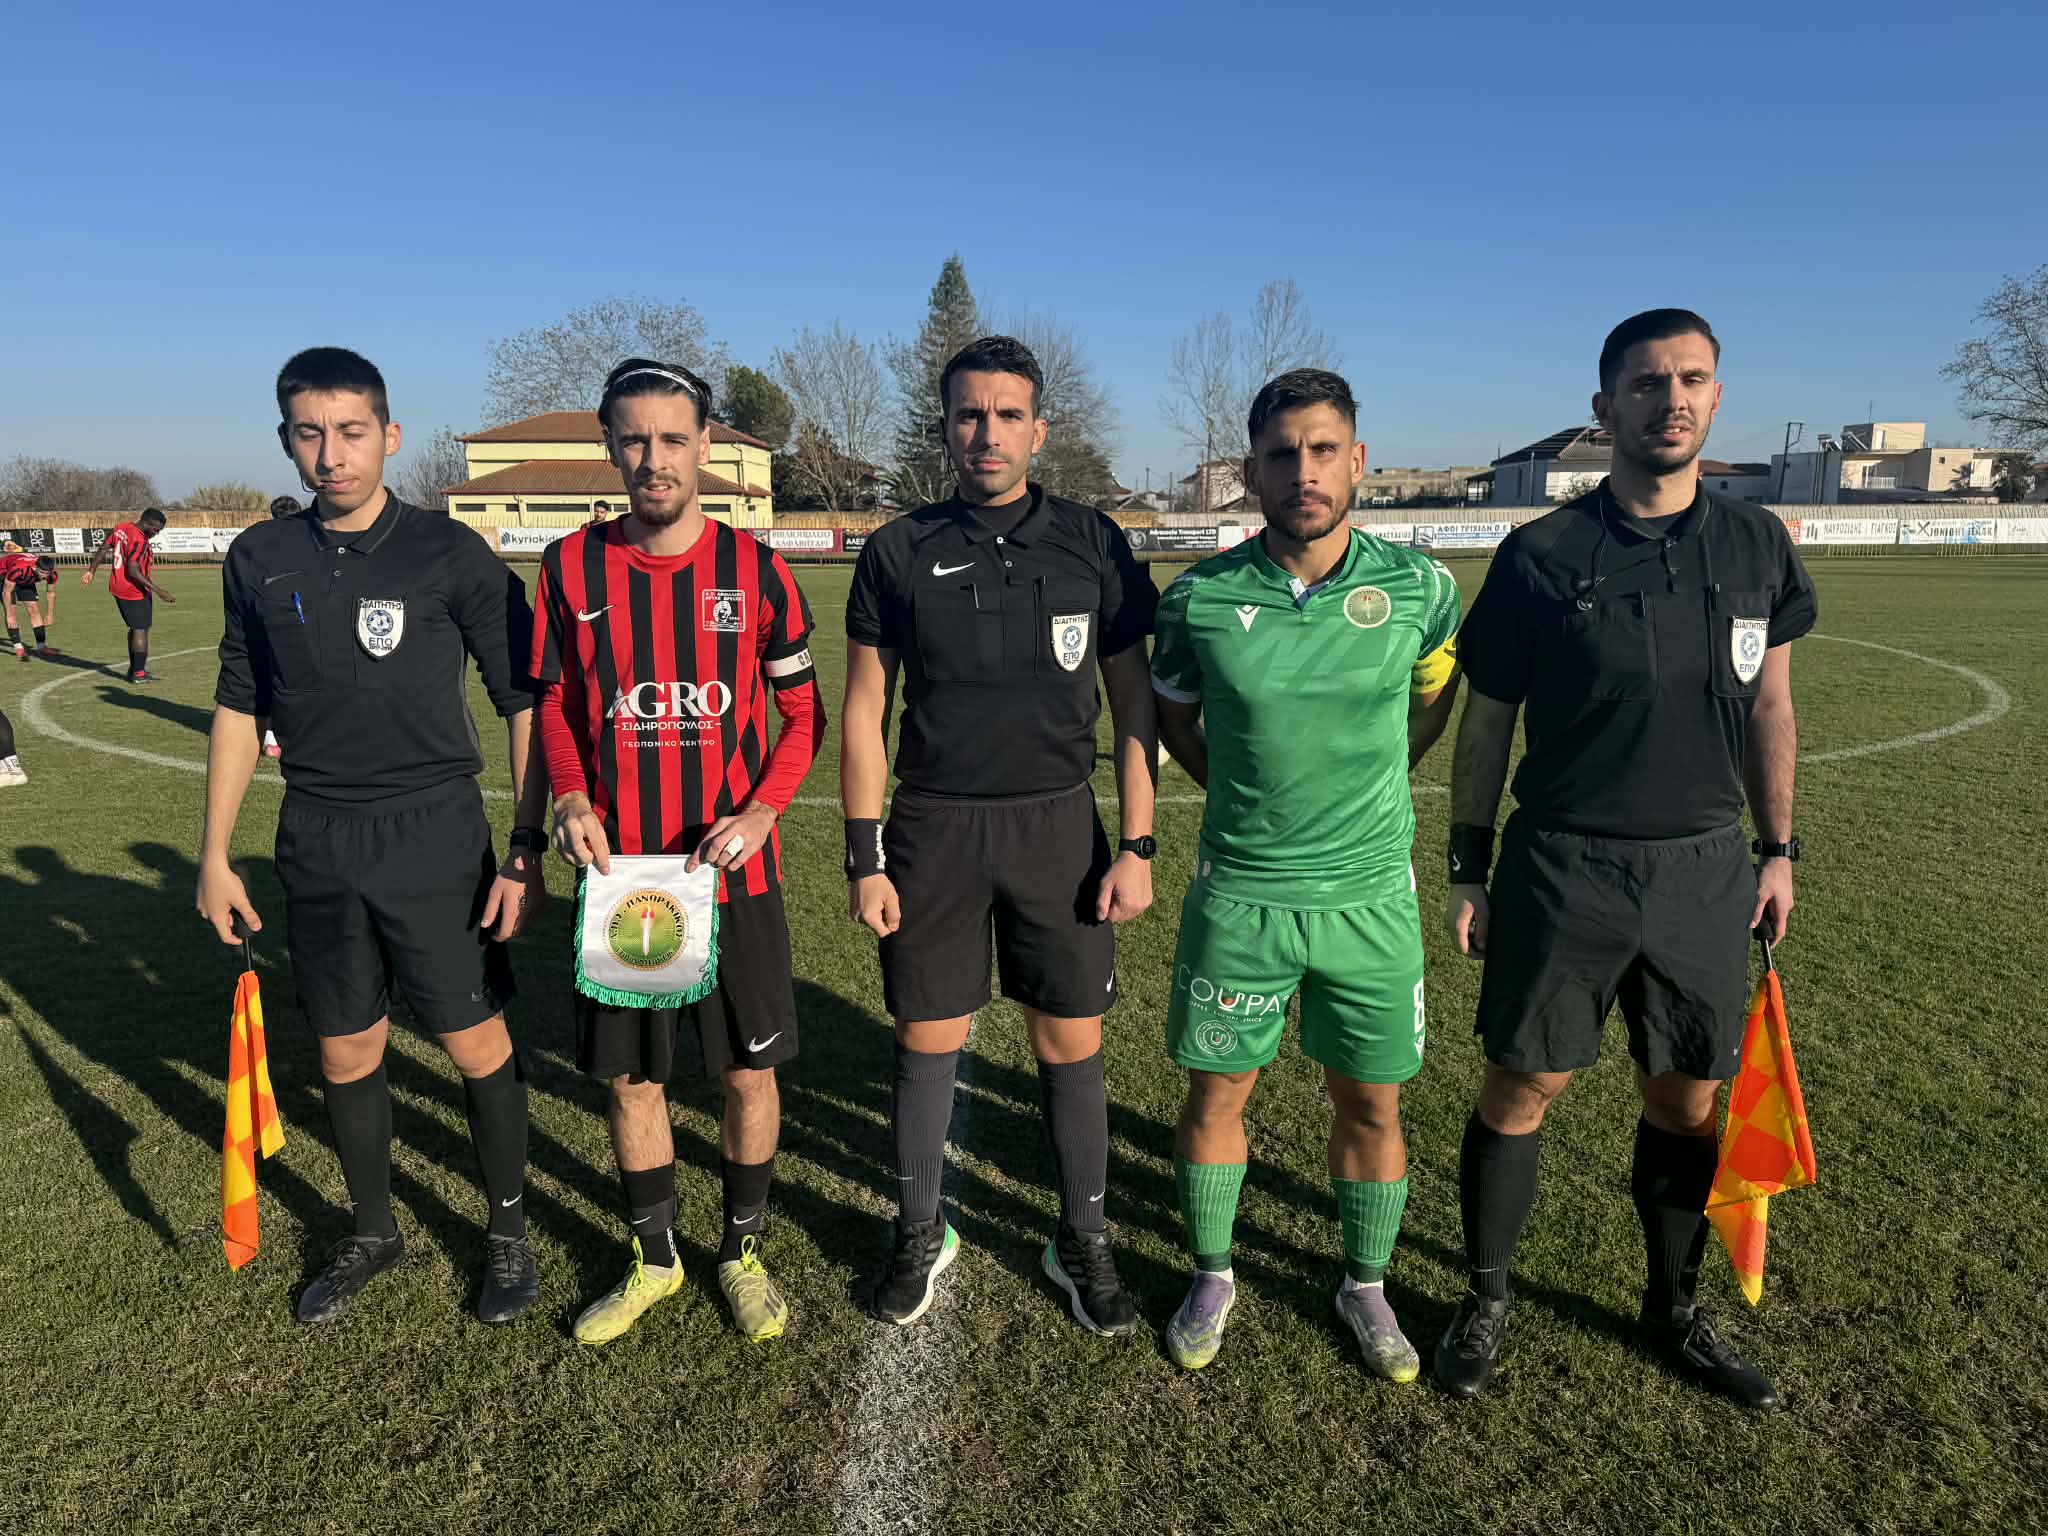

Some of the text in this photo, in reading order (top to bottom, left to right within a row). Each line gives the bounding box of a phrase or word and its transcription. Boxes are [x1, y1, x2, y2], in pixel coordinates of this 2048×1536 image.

[368, 637, 393, 646] ΕΠΟ
[1063, 651, 1080, 661] ΕΠΟ
[1739, 663, 1756, 673] ΕΠΟ
[605, 680, 732, 719] AGRO
[680, 739, 716, 747] ΚΕΝΤΡΟ
[1179, 963, 1281, 1016] COUPA
